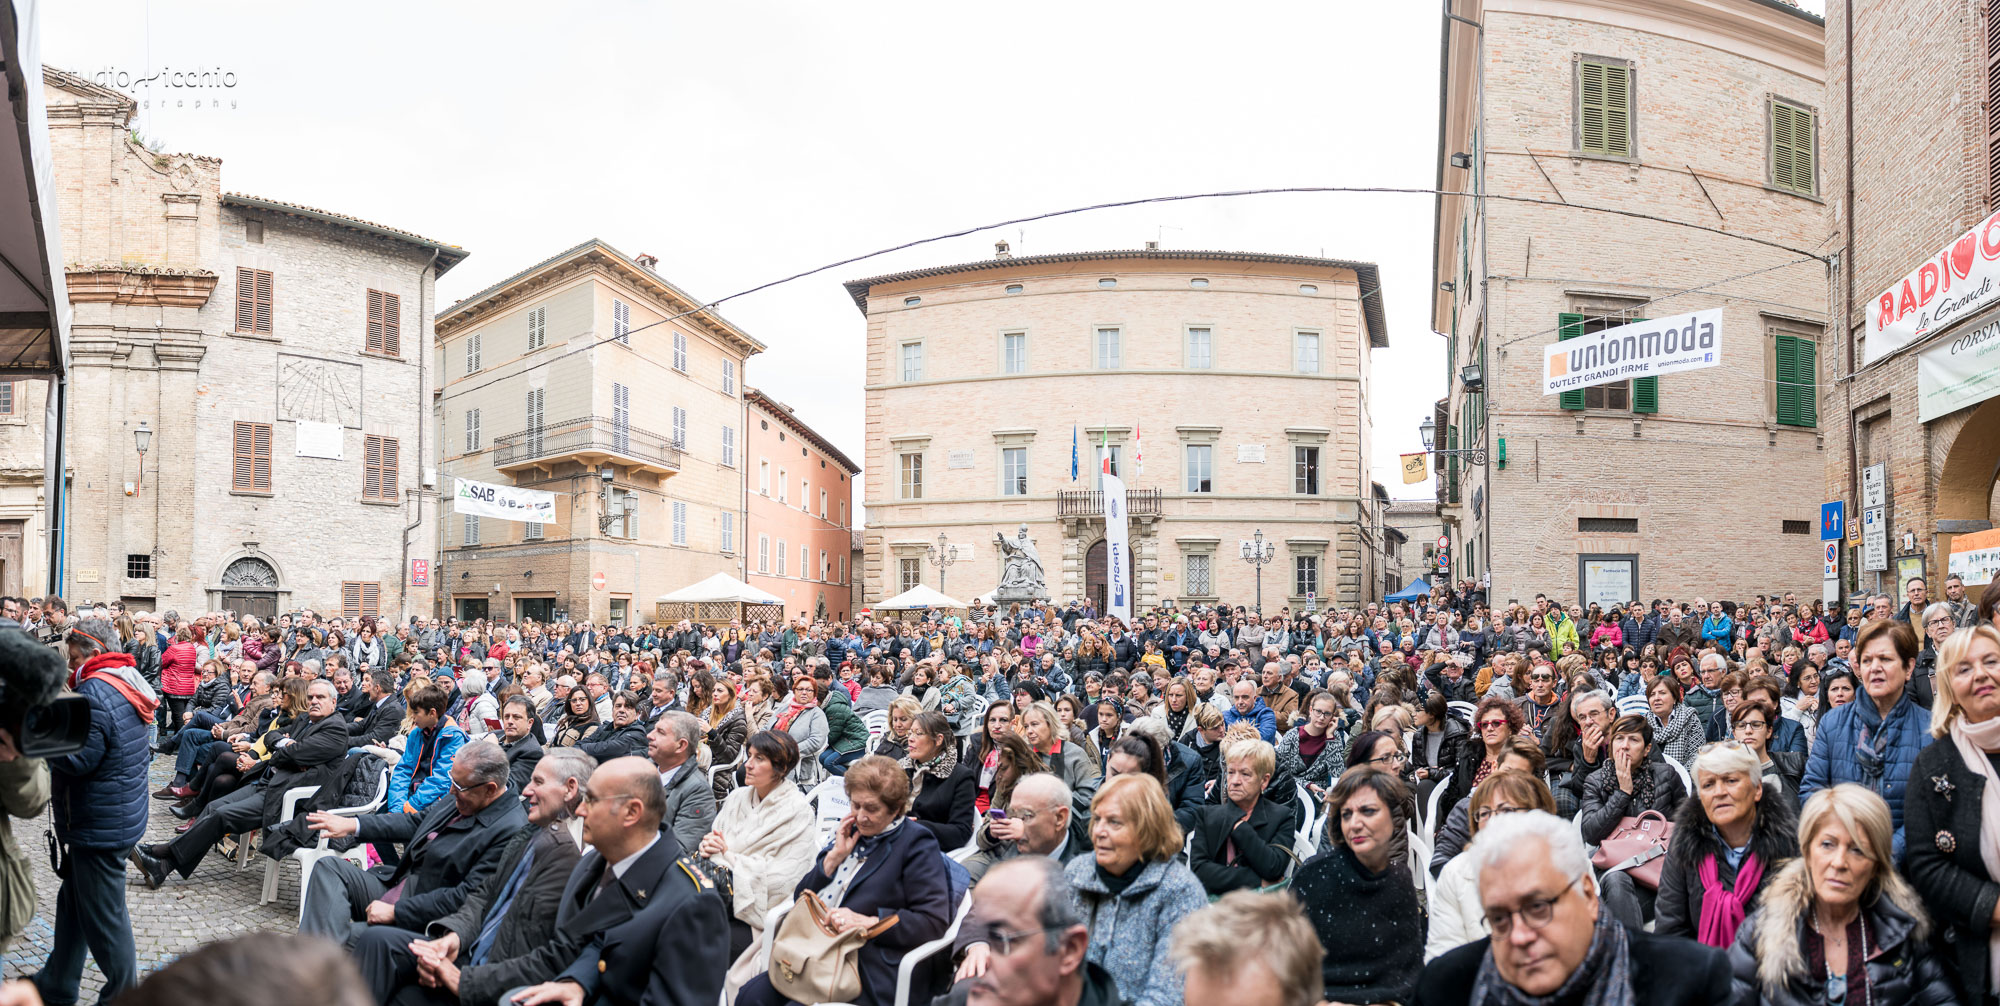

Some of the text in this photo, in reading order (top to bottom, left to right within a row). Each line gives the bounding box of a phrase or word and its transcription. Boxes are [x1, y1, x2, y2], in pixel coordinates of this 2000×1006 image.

[1934, 277, 1993, 321] Grandi
[1571, 316, 1714, 372] unionmoda
[1549, 362, 1649, 389] OUTLET GRANDI FIRME
[1657, 356, 1703, 368] unionmoda.com
[470, 485, 495, 502] SAB
